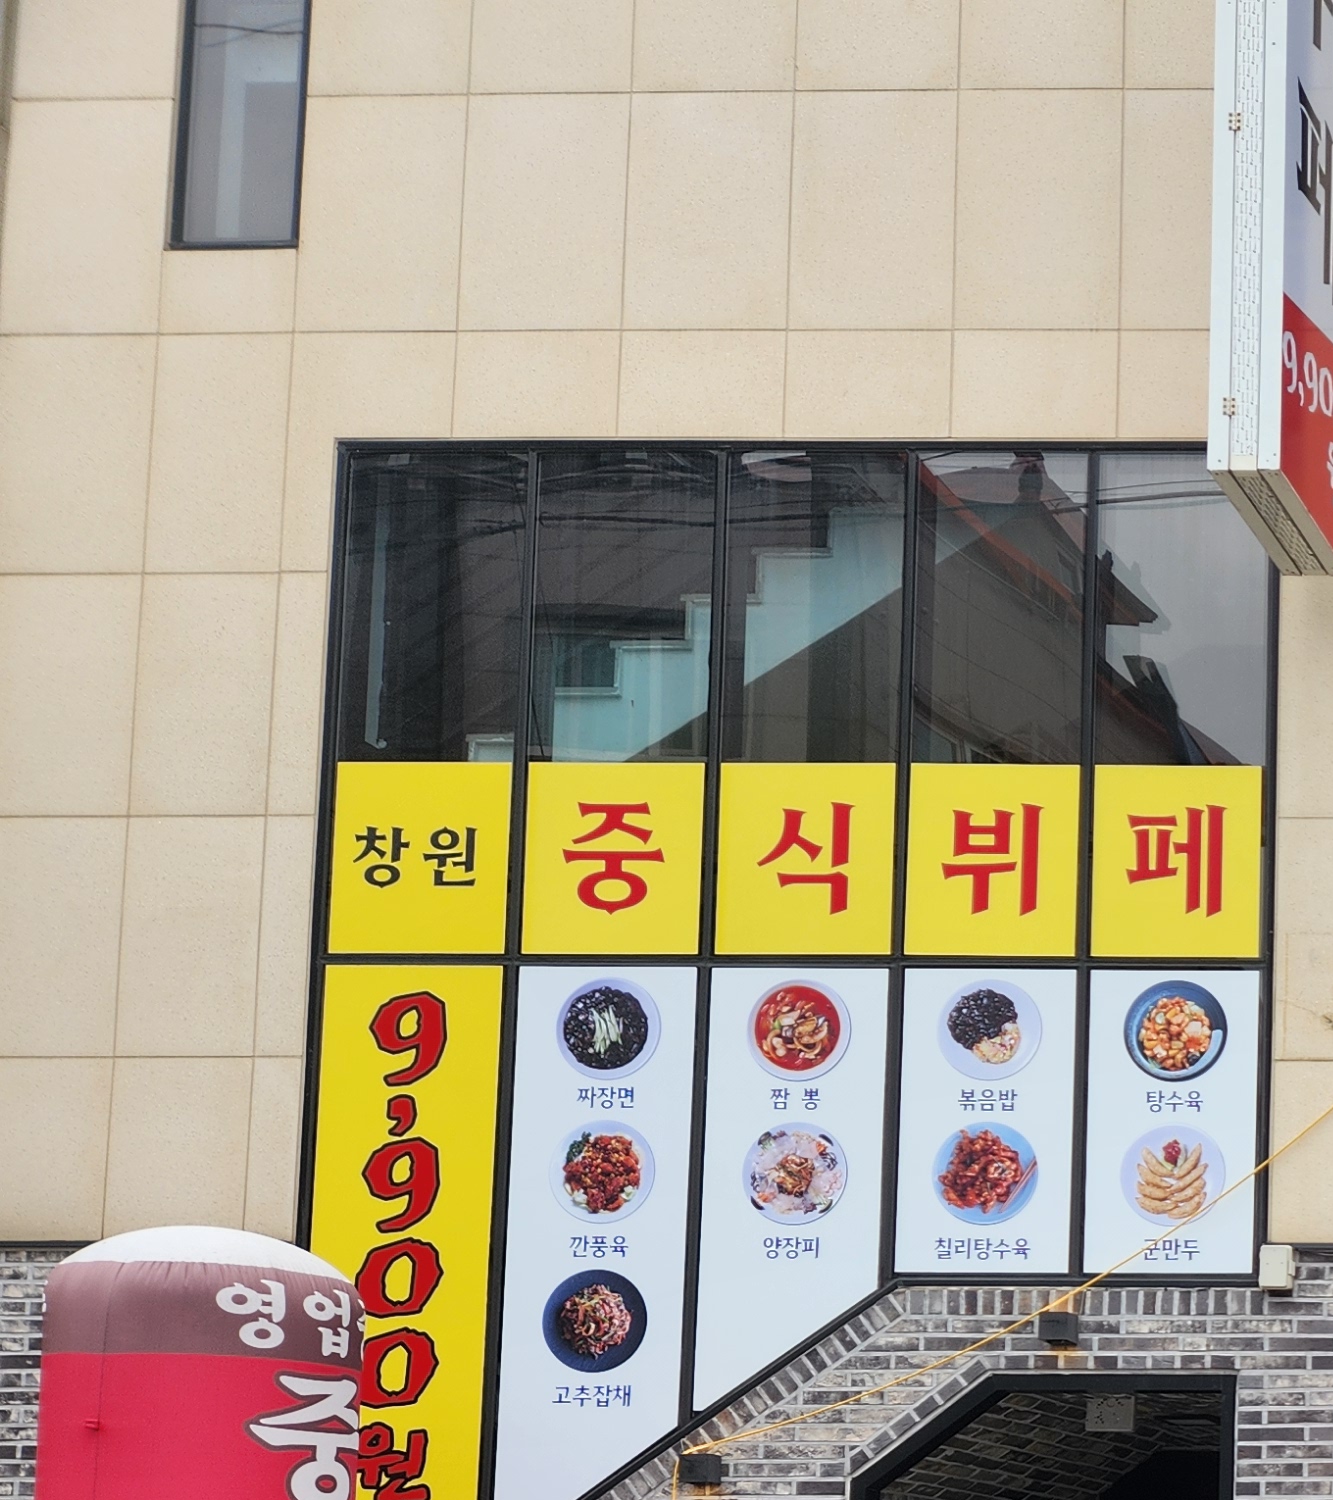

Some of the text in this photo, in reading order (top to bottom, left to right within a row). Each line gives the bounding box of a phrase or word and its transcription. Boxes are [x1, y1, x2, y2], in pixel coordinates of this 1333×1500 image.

[353, 825, 478, 890] 창원
[577, 1085, 635, 1111] 짜장면
[957, 1087, 1017, 1113] 볶음밥
[1145, 1089, 1204, 1113] 탕수육
[569, 1233, 629, 1259] 깐풍육
[763, 1235, 820, 1260] 양장피
[933, 1236, 1032, 1261] 칠리탕수육
[1142, 1237, 1201, 1262] 군만두
[216, 1279, 366, 1362] 영업
[552, 1385, 632, 1408] 고추잡채
